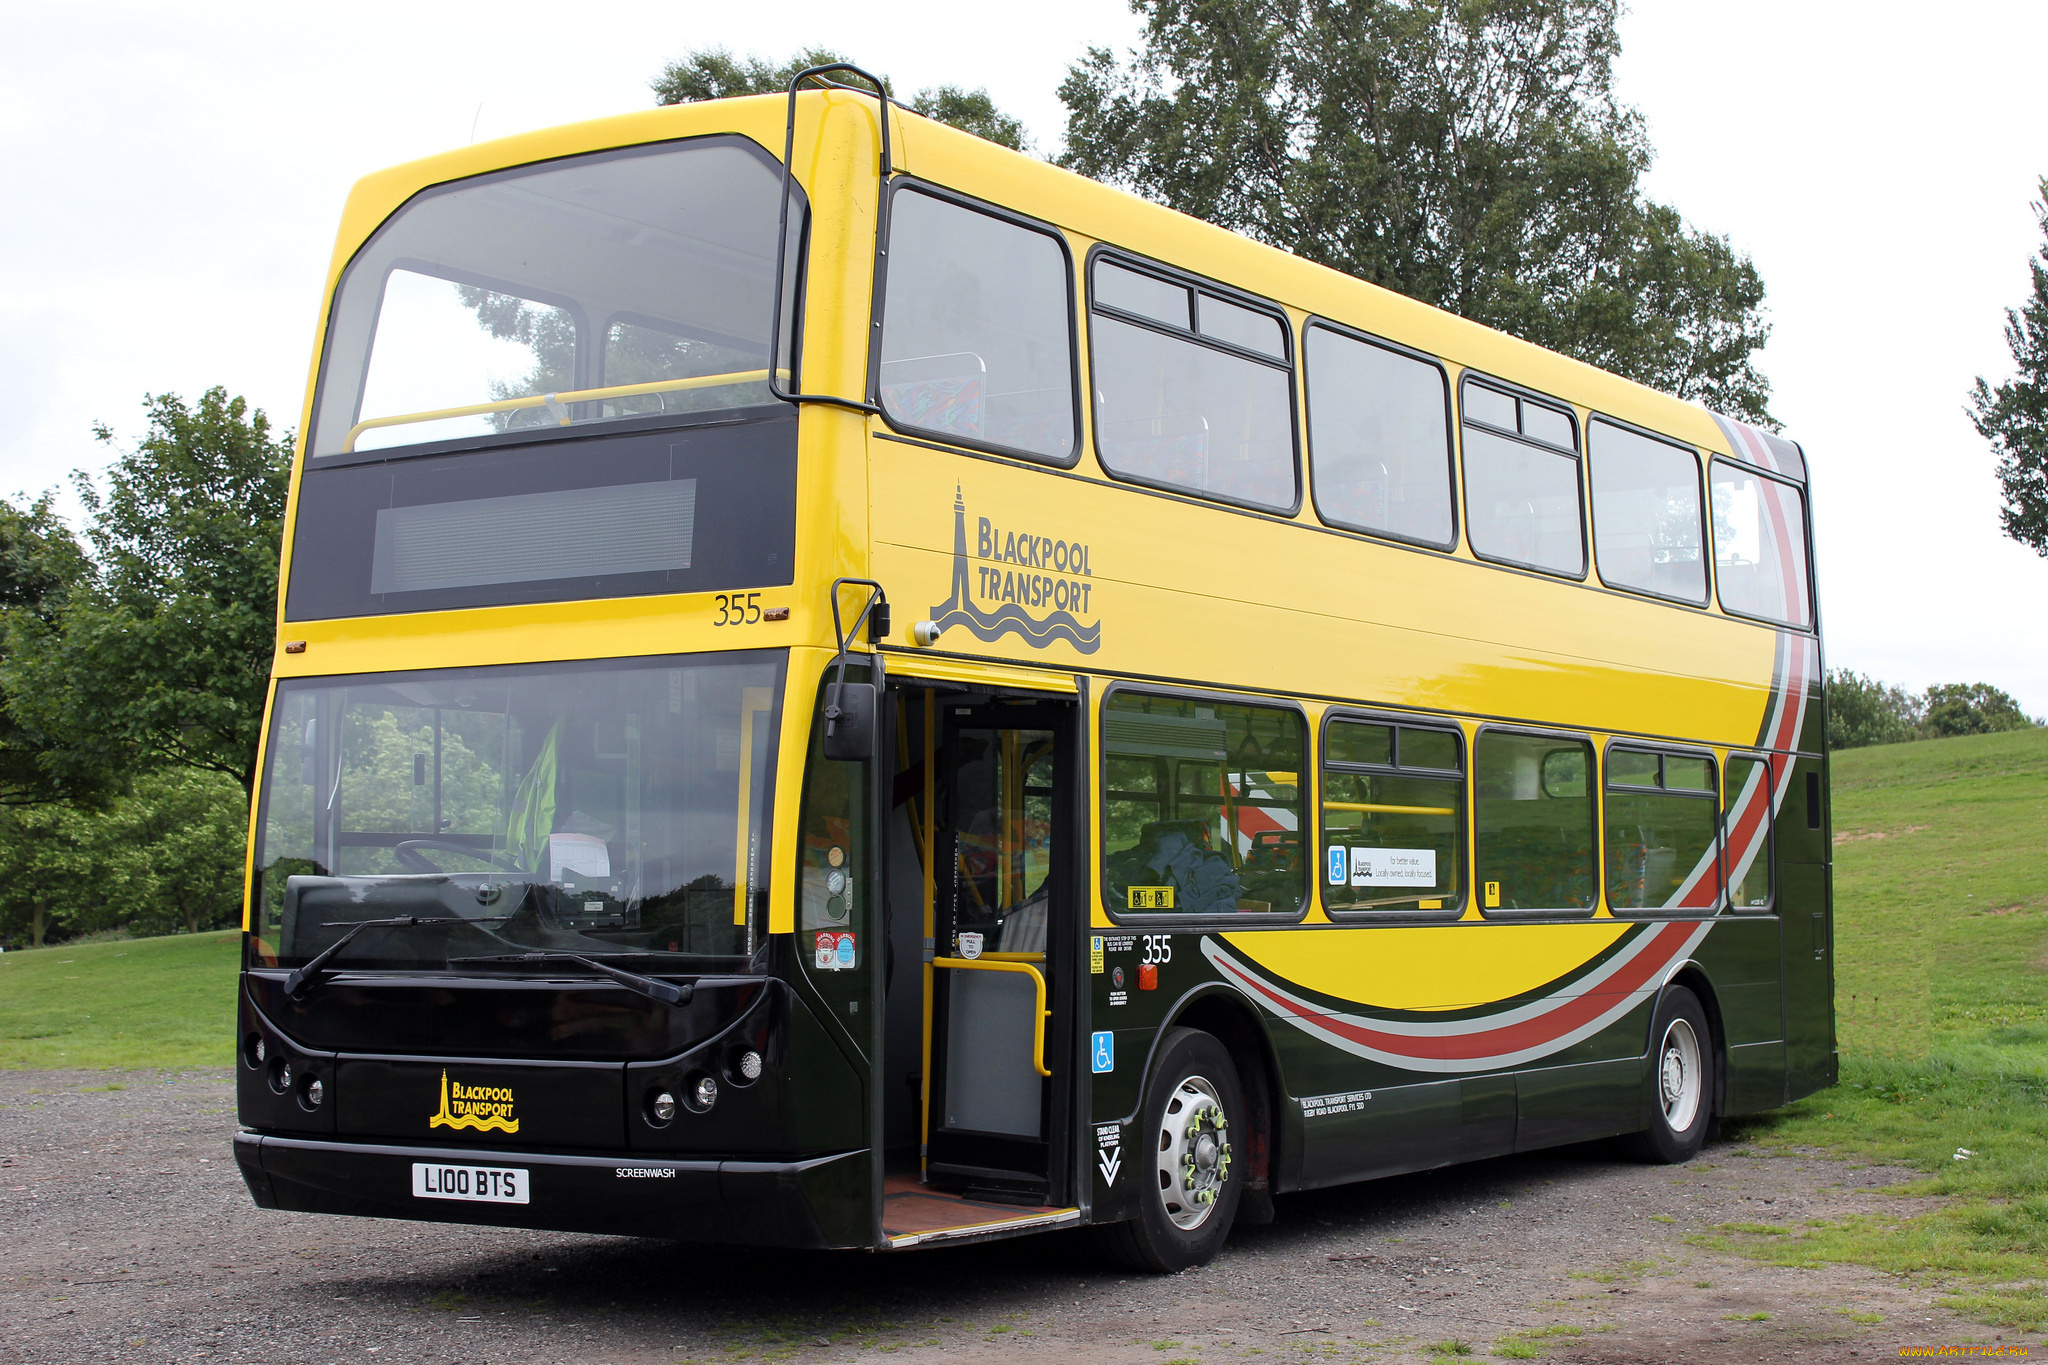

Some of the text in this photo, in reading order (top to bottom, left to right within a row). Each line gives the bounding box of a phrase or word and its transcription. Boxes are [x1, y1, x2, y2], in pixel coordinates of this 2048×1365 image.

[977, 516, 1092, 576] BLACKPOOL
[978, 566, 1092, 614] TRANSPORT
[713, 593, 761, 626] 355
[1142, 934, 1172, 964] 355
[452, 1081, 514, 1102] BLACKPOOL
[452, 1100, 514, 1117] TRANSPORT
[425, 1167, 516, 1197] L100 BTS
[616, 1167, 676, 1178] SCREENWASH
